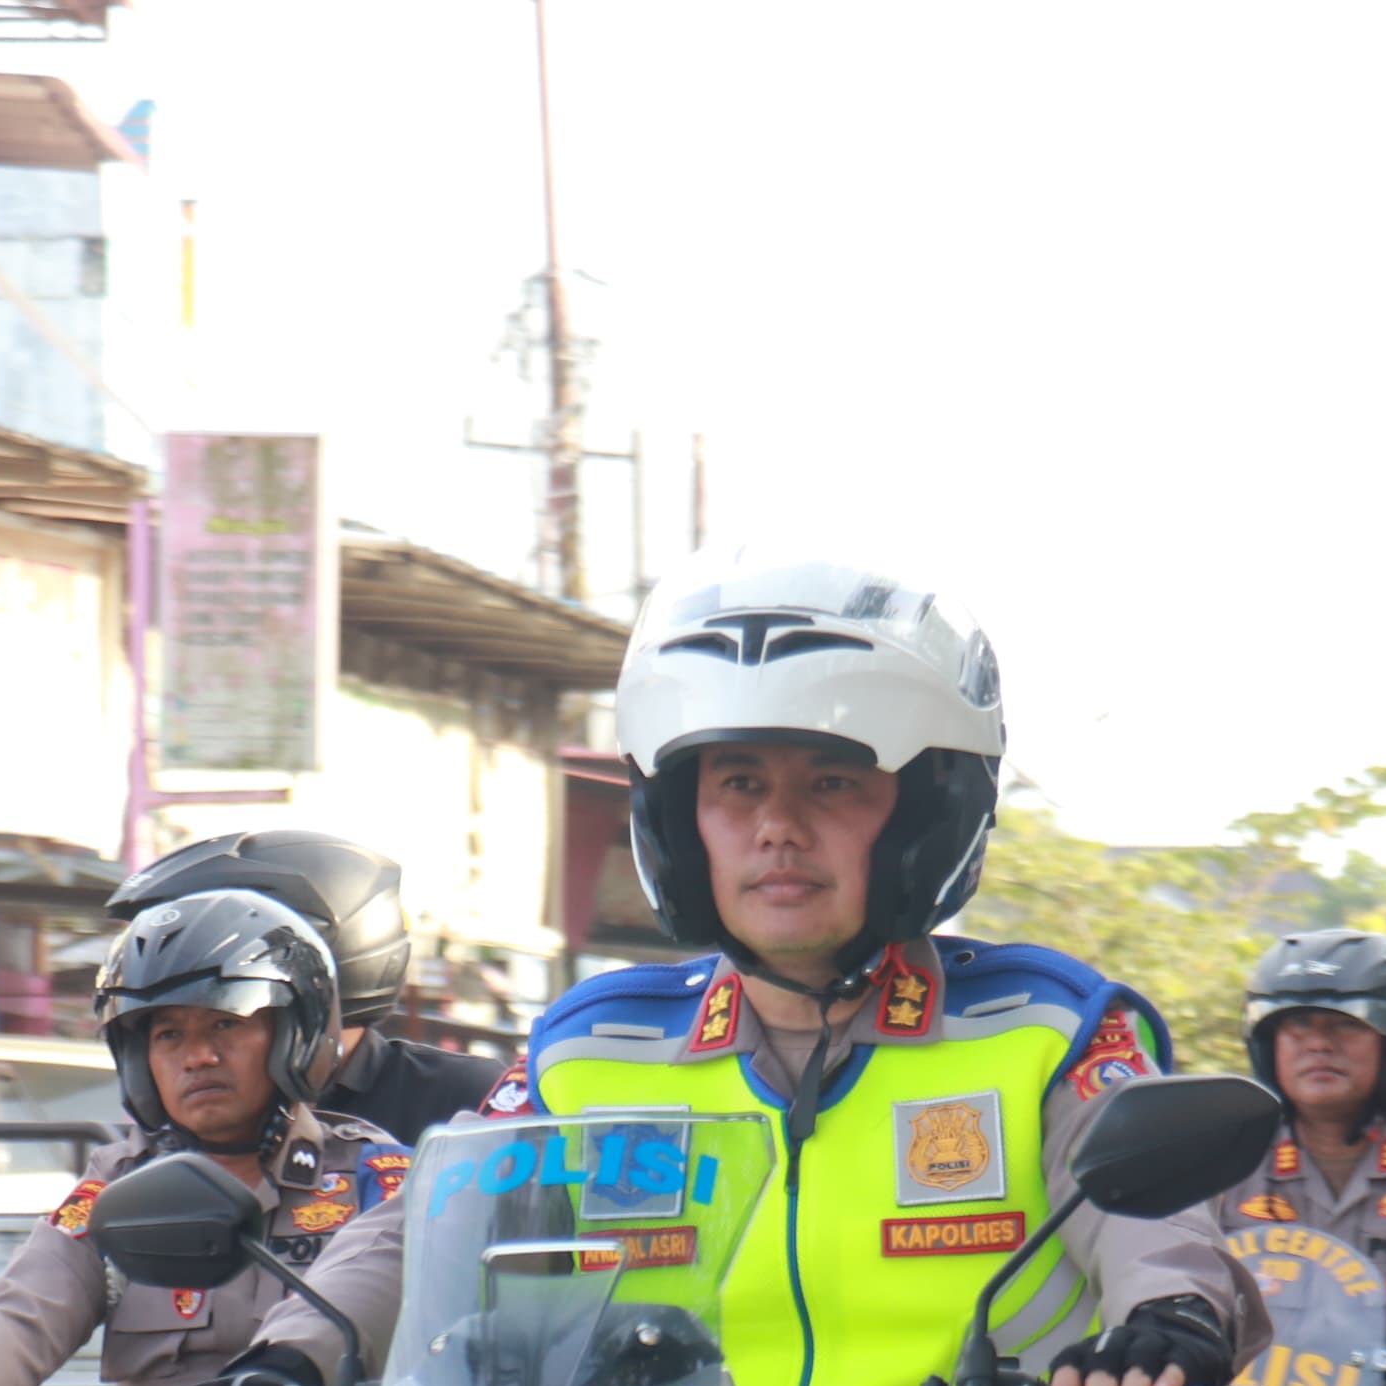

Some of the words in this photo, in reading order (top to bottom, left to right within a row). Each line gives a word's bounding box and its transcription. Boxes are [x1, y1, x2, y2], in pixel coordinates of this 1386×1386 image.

[426, 1135, 719, 1218] POLISI
[928, 1160, 970, 1172] POLISI
[649, 1233, 687, 1258] ASRI
[890, 1219, 1017, 1249] KAPOLRES
[1265, 1226, 1379, 1298] CENTRE
